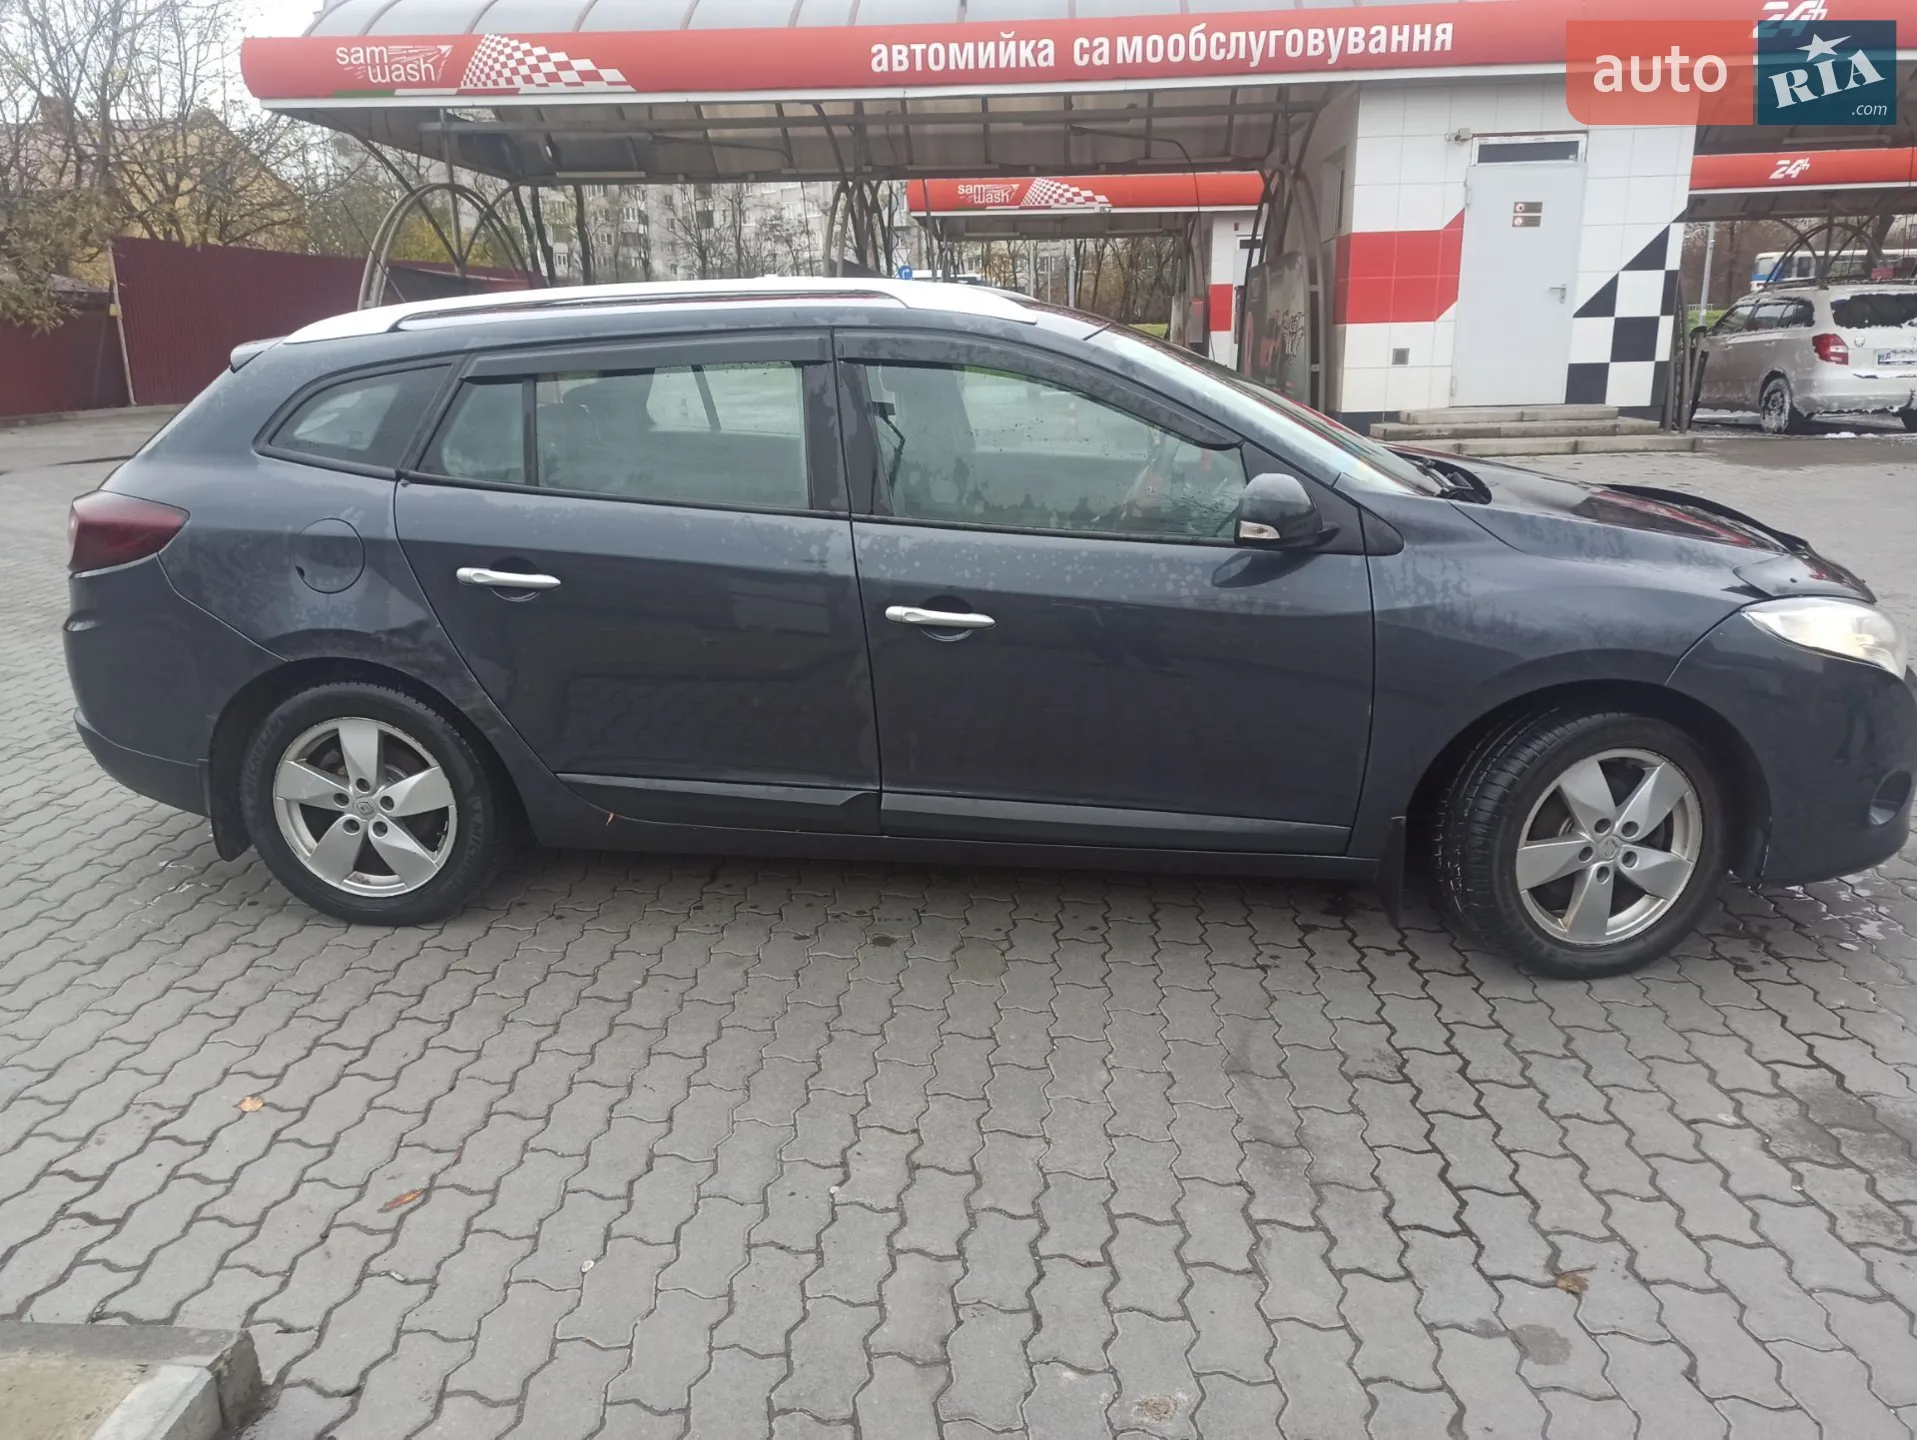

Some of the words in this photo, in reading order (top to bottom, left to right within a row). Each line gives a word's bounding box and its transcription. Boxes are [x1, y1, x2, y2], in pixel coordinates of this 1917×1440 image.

[335, 46, 389, 65] sam
[870, 31, 1055, 73] автомийка
[1073, 23, 1454, 67] самообслуговування
[367, 57, 436, 83] wash
[957, 184, 986, 195] sam
[973, 189, 1010, 204] wash
